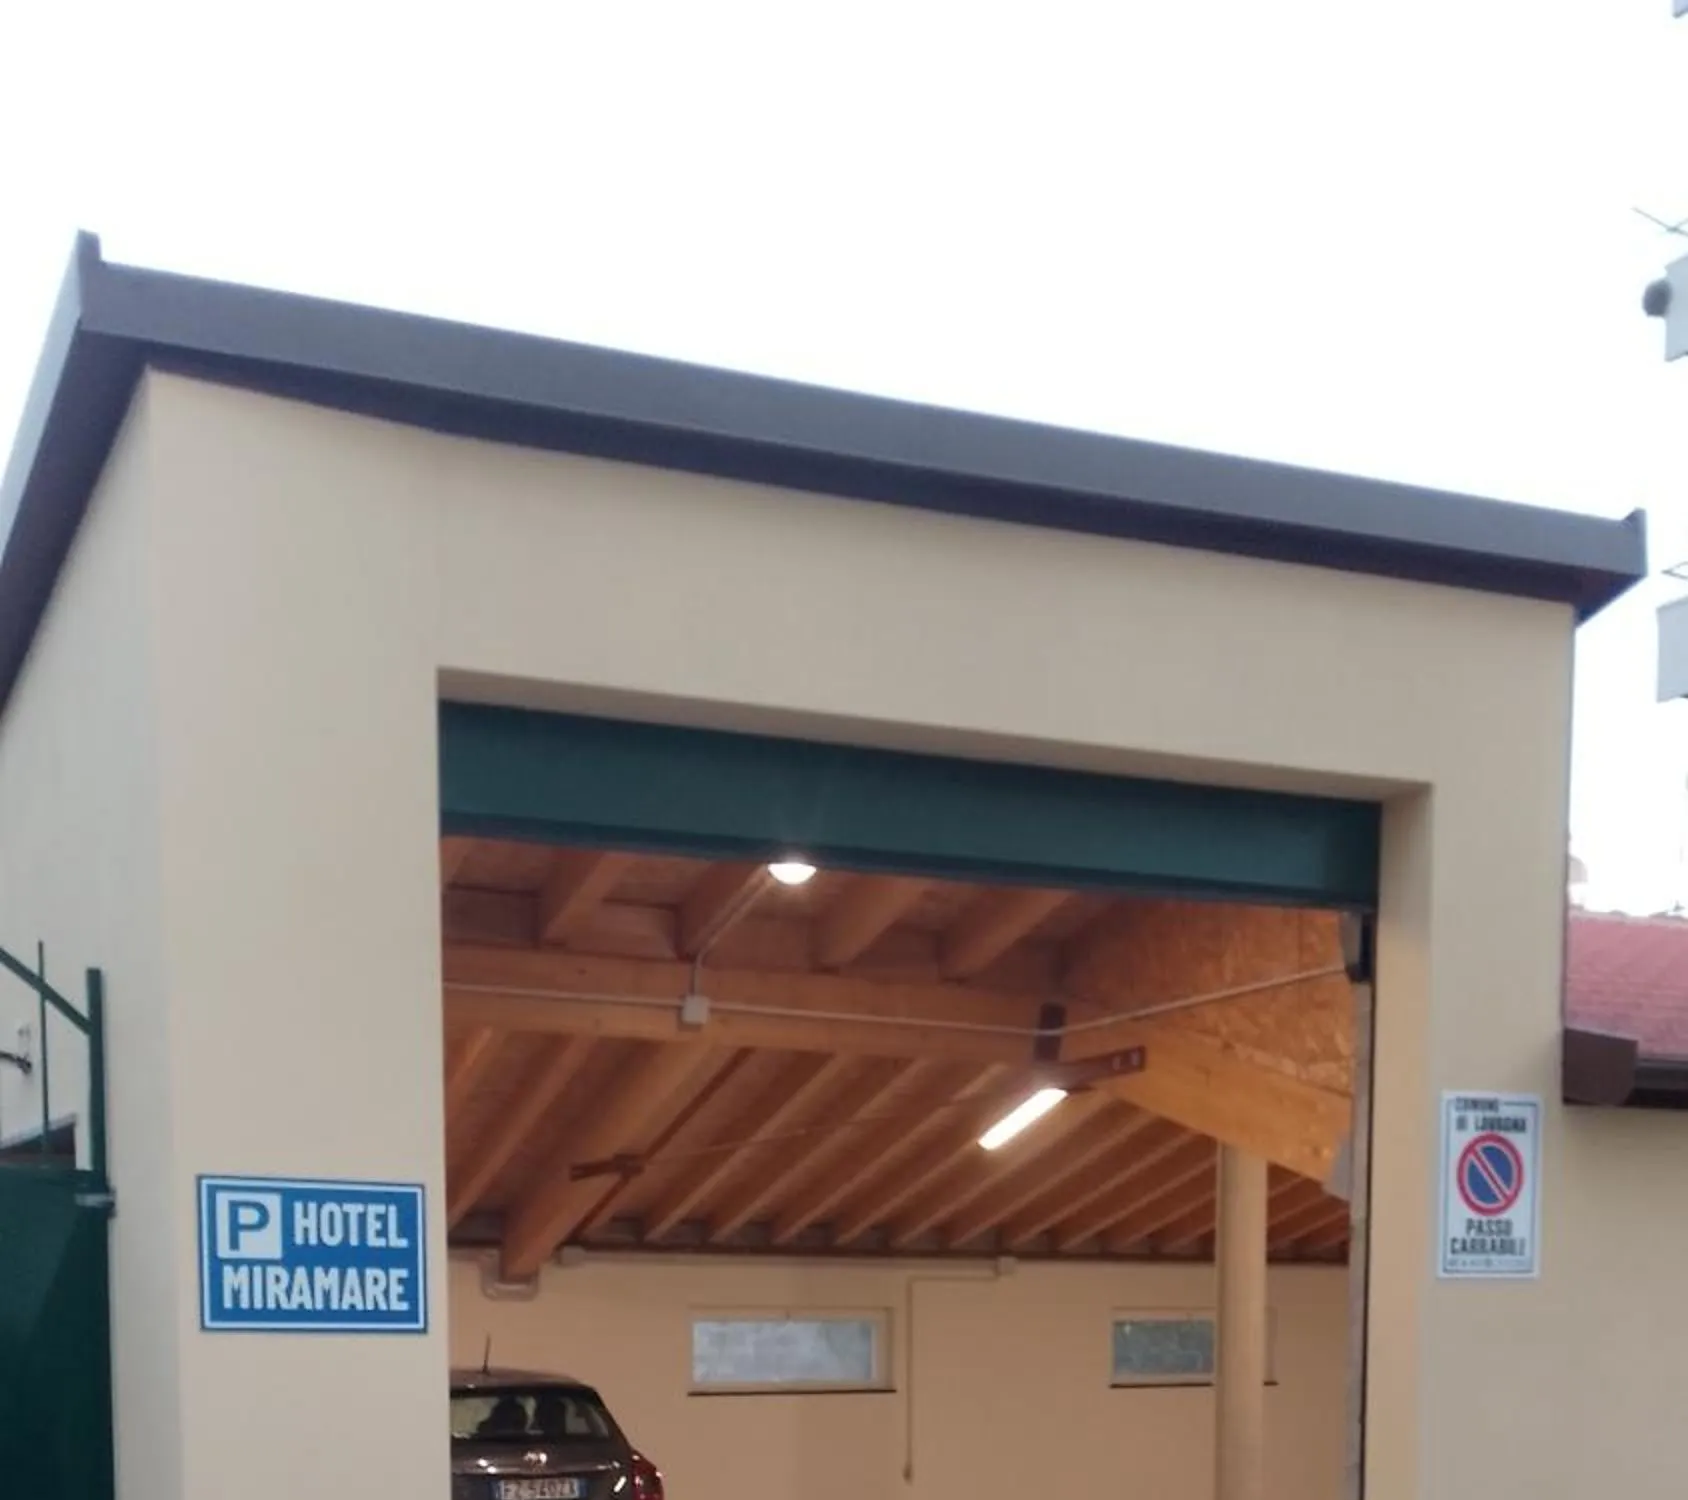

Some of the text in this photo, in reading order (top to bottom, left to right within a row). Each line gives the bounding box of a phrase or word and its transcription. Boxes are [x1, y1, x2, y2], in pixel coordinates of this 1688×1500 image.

[228, 1200, 408, 1251] P HOTEL
[1466, 1218, 1513, 1236] PASSO
[223, 1265, 410, 1311] MIRAMARE
